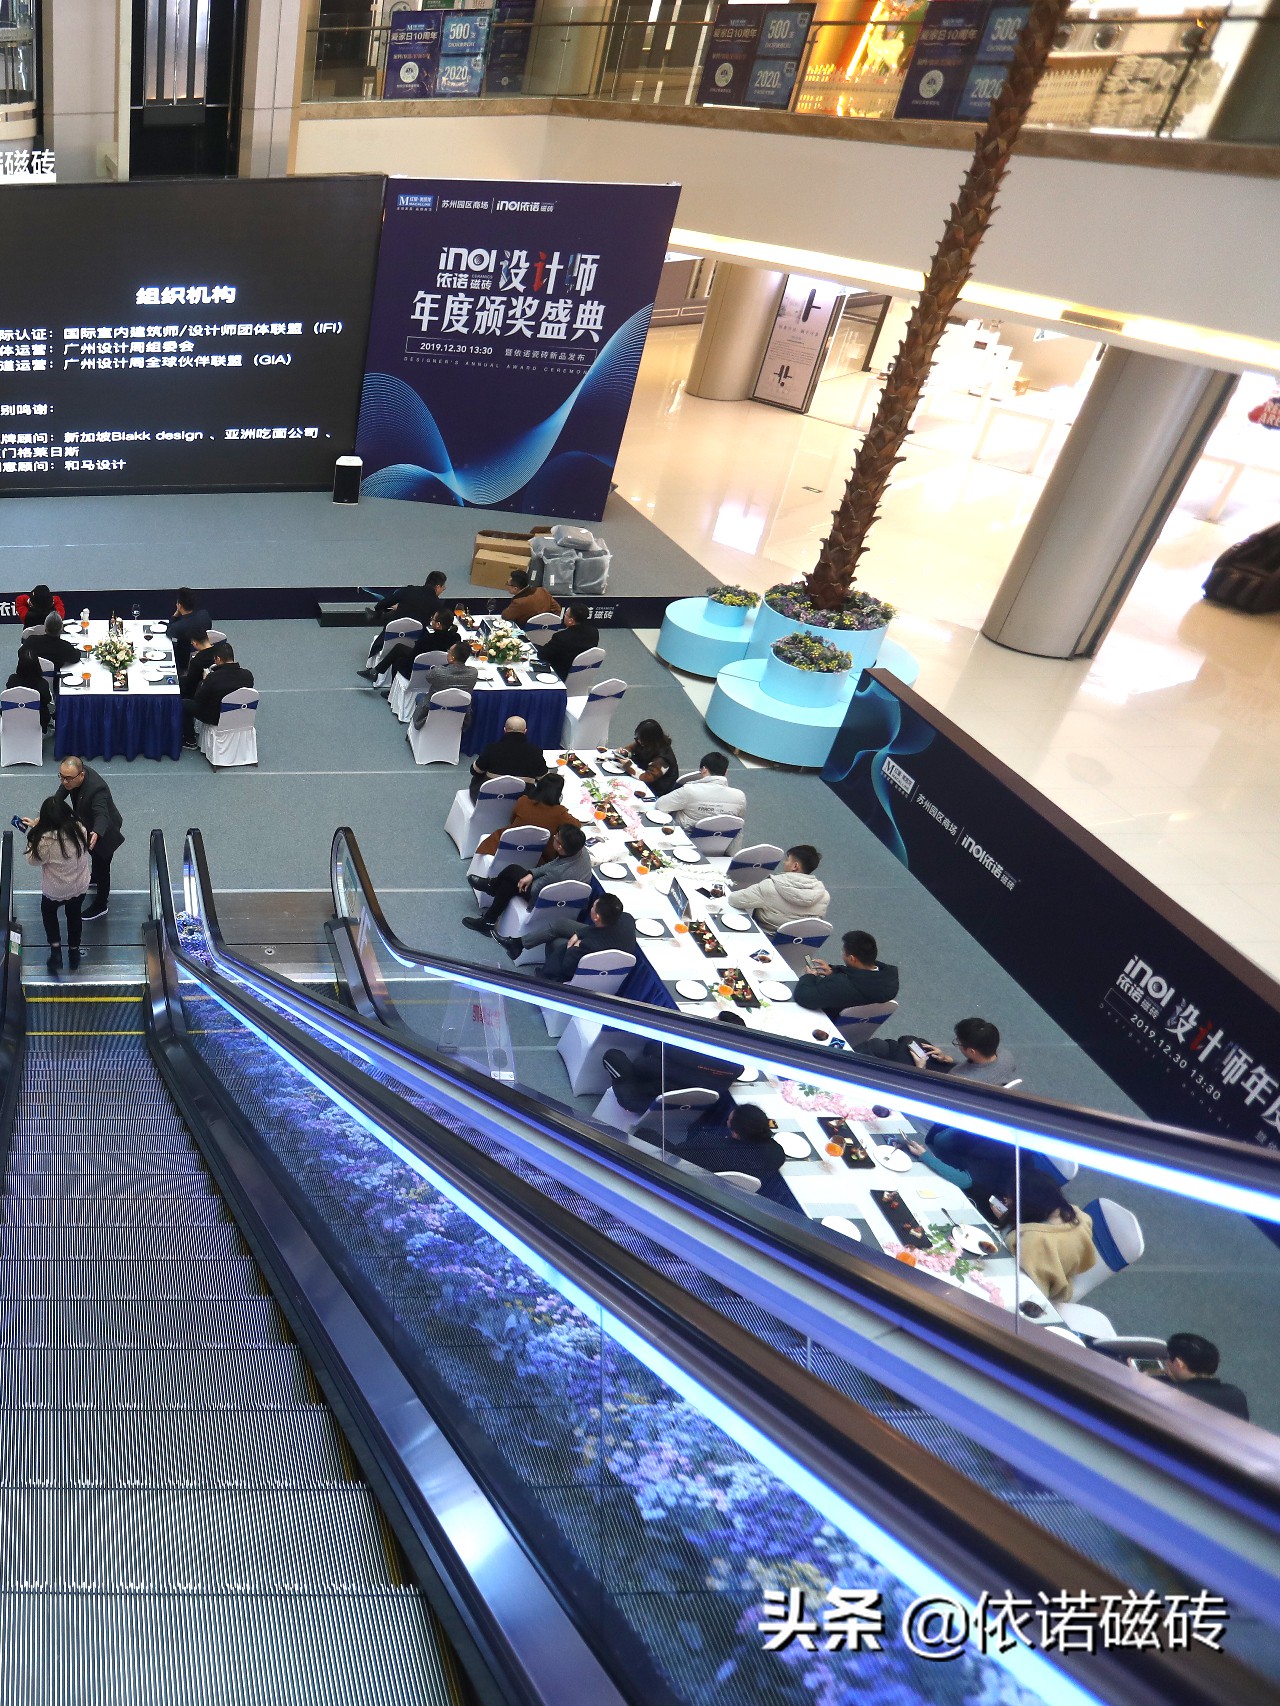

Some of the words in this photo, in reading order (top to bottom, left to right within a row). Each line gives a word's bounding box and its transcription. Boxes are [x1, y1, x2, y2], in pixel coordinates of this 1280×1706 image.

[449, 22, 470, 40] 500
[767, 19, 791, 40] 500
[444, 65, 469, 81] 2020
[754, 70, 781, 89] 2020
[441, 199, 489, 210] 苏州园区商场
[498, 249, 601, 297] 设计师
[135, 286, 237, 305] 组织机构
[410, 290, 607, 344] 年度颁奖盛典
[420, 341, 467, 355] 2019.12.30
[469, 345, 493, 356] 13:30
[465, 360, 500, 369] ANNUAL
[506, 364, 537, 372] AWARD
[916, 793, 958, 836] 苏州园区商场
[1130, 1013, 1188, 1070] 2019.12.30
[1190, 1069, 1221, 1101] 13:30
